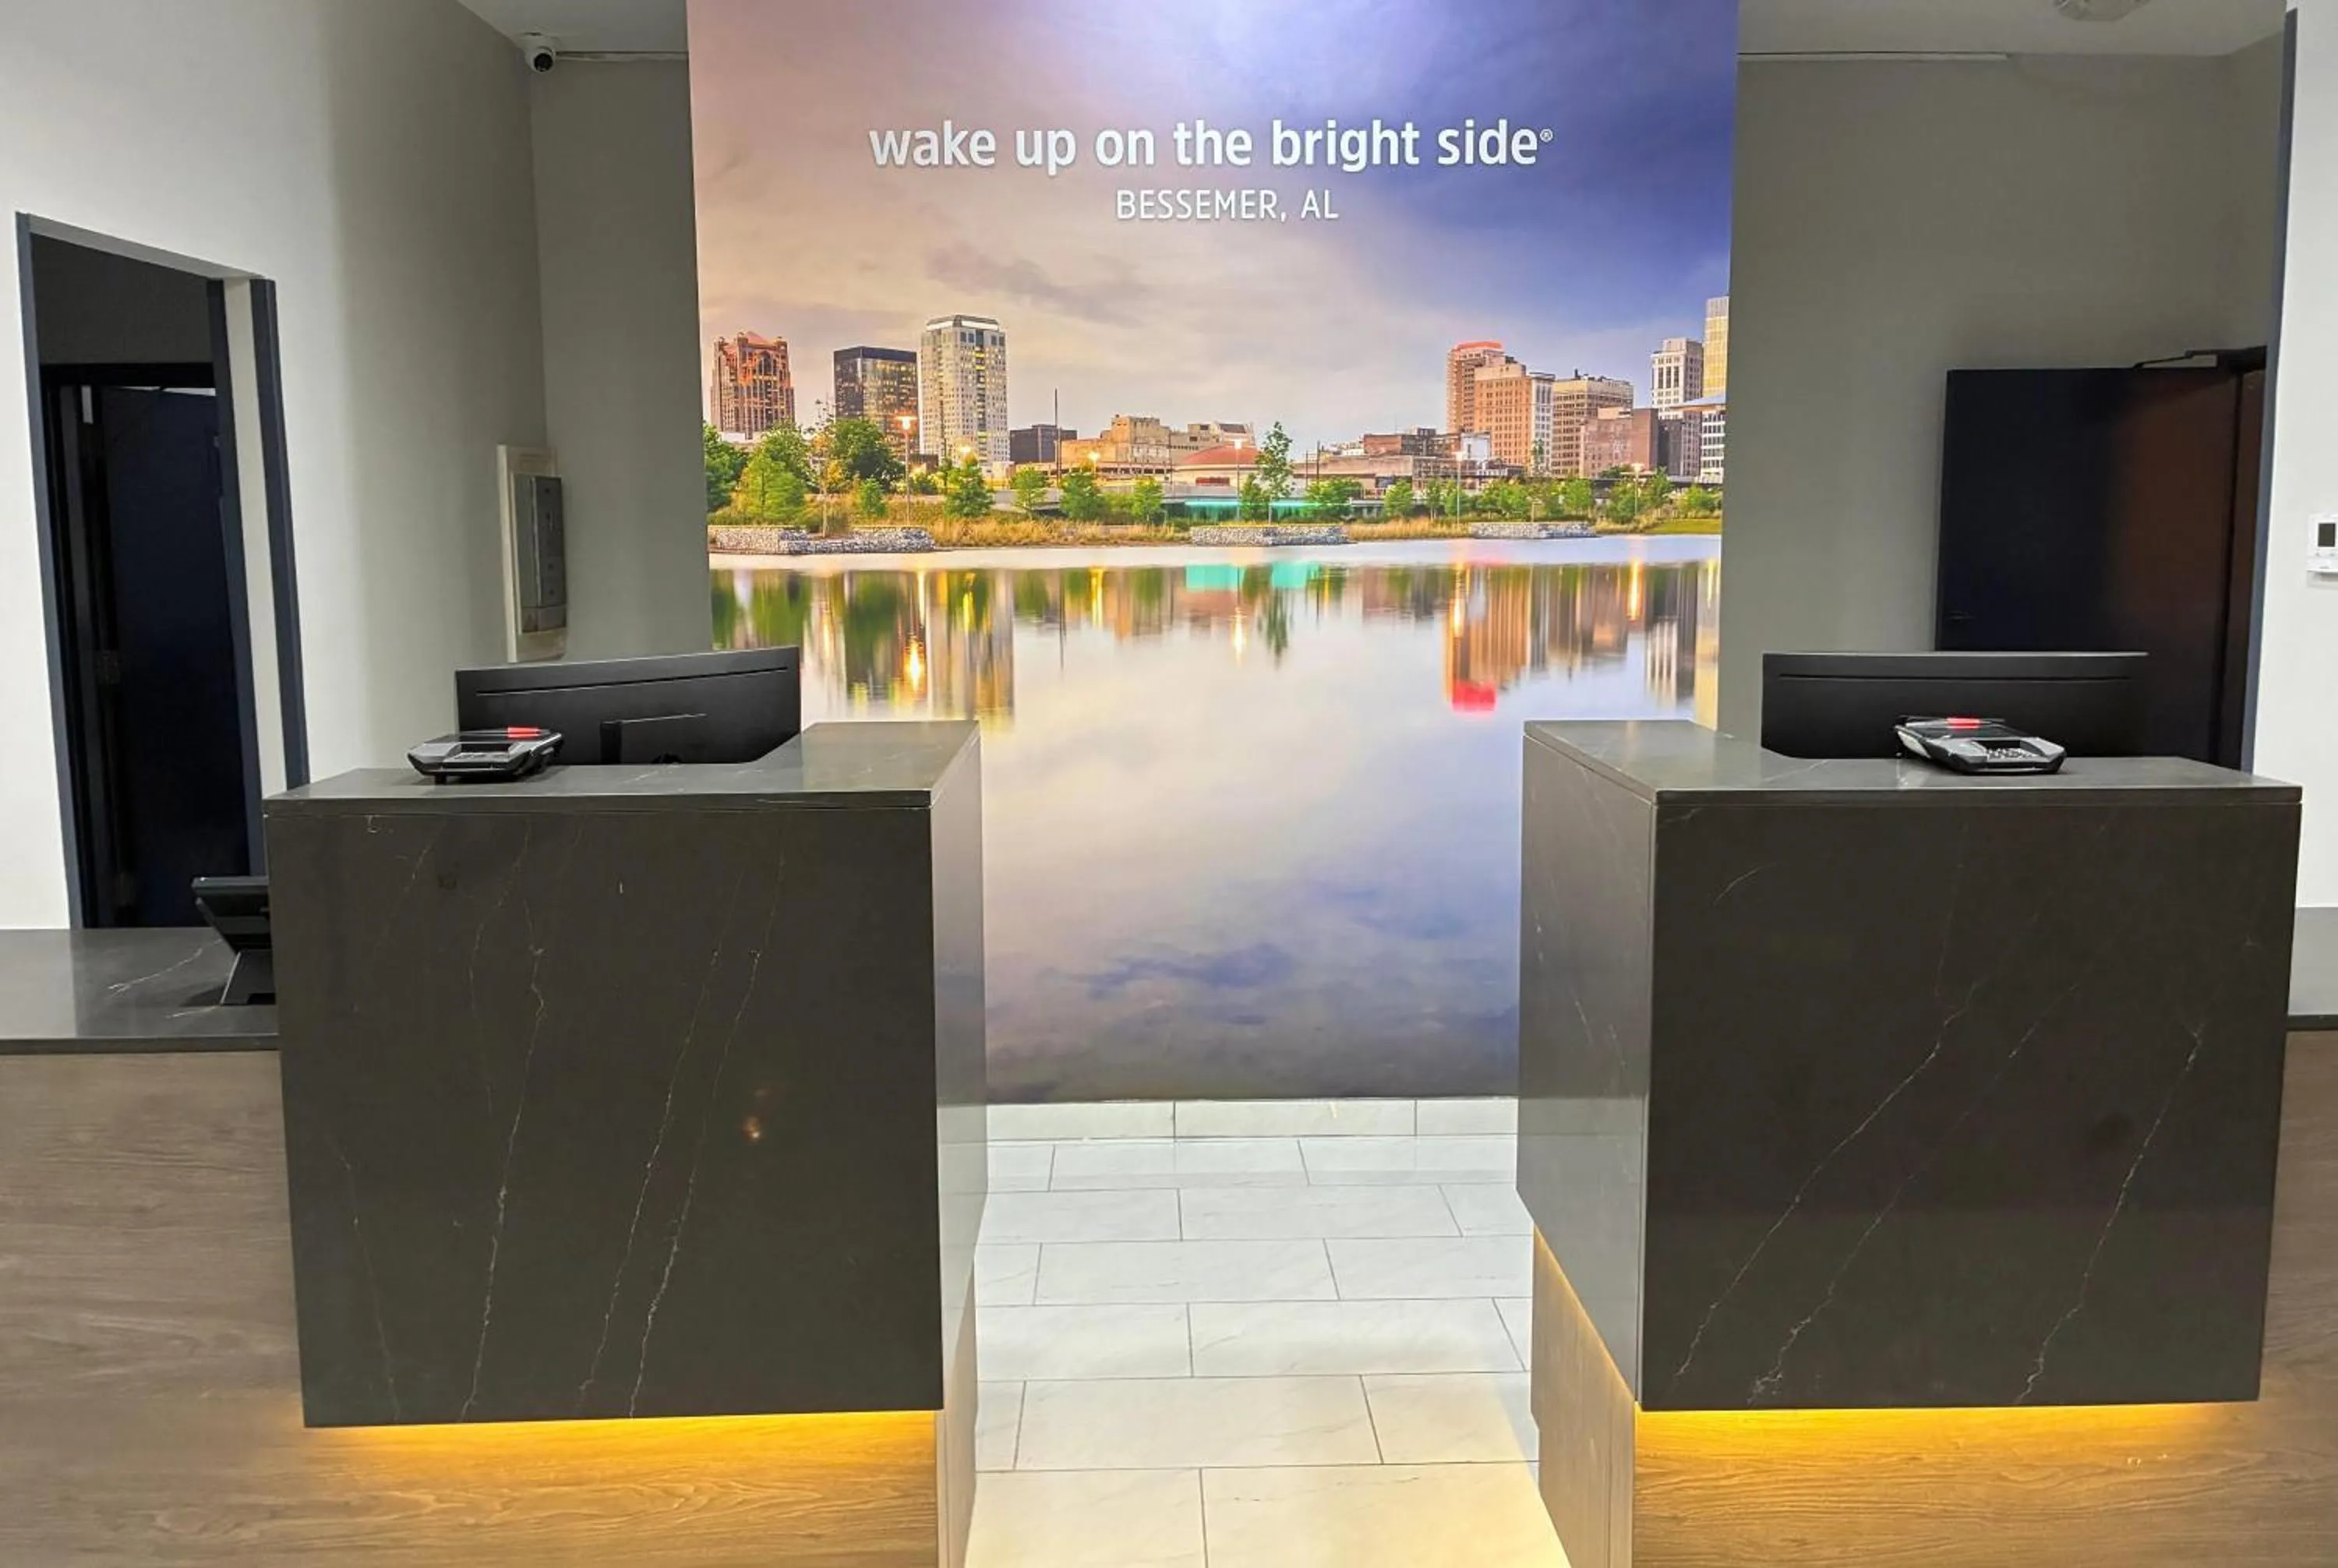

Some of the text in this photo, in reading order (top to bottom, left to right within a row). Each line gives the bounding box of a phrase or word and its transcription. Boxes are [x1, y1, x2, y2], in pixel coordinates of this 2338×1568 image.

[868, 119, 997, 166] wake
[1015, 129, 1077, 177] up
[1096, 129, 1155, 166] on
[1172, 119, 1253, 166] the
[1273, 119, 1421, 172] bright
[1117, 189, 1340, 222] BESSEMER, AL
